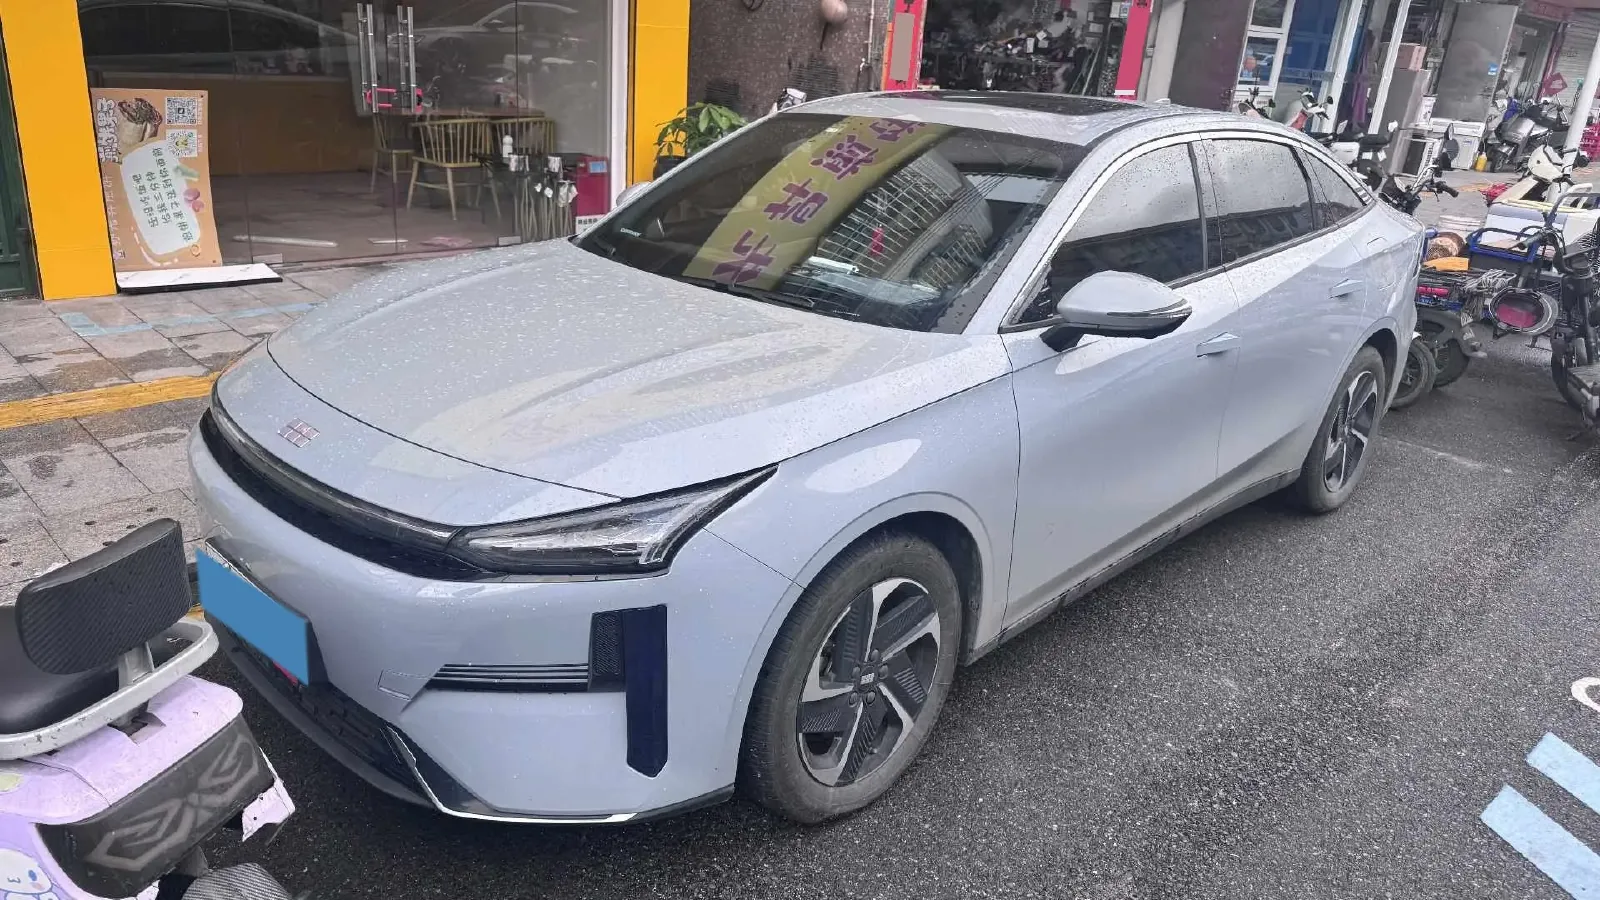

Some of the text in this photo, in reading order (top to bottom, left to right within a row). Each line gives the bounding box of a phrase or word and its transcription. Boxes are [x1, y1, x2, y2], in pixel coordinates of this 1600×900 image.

[97, 97, 120, 164] 煎饼果子
[132, 173, 159, 228] 还没吃饭吧
[146, 171, 171, 224] 给我三分钟
